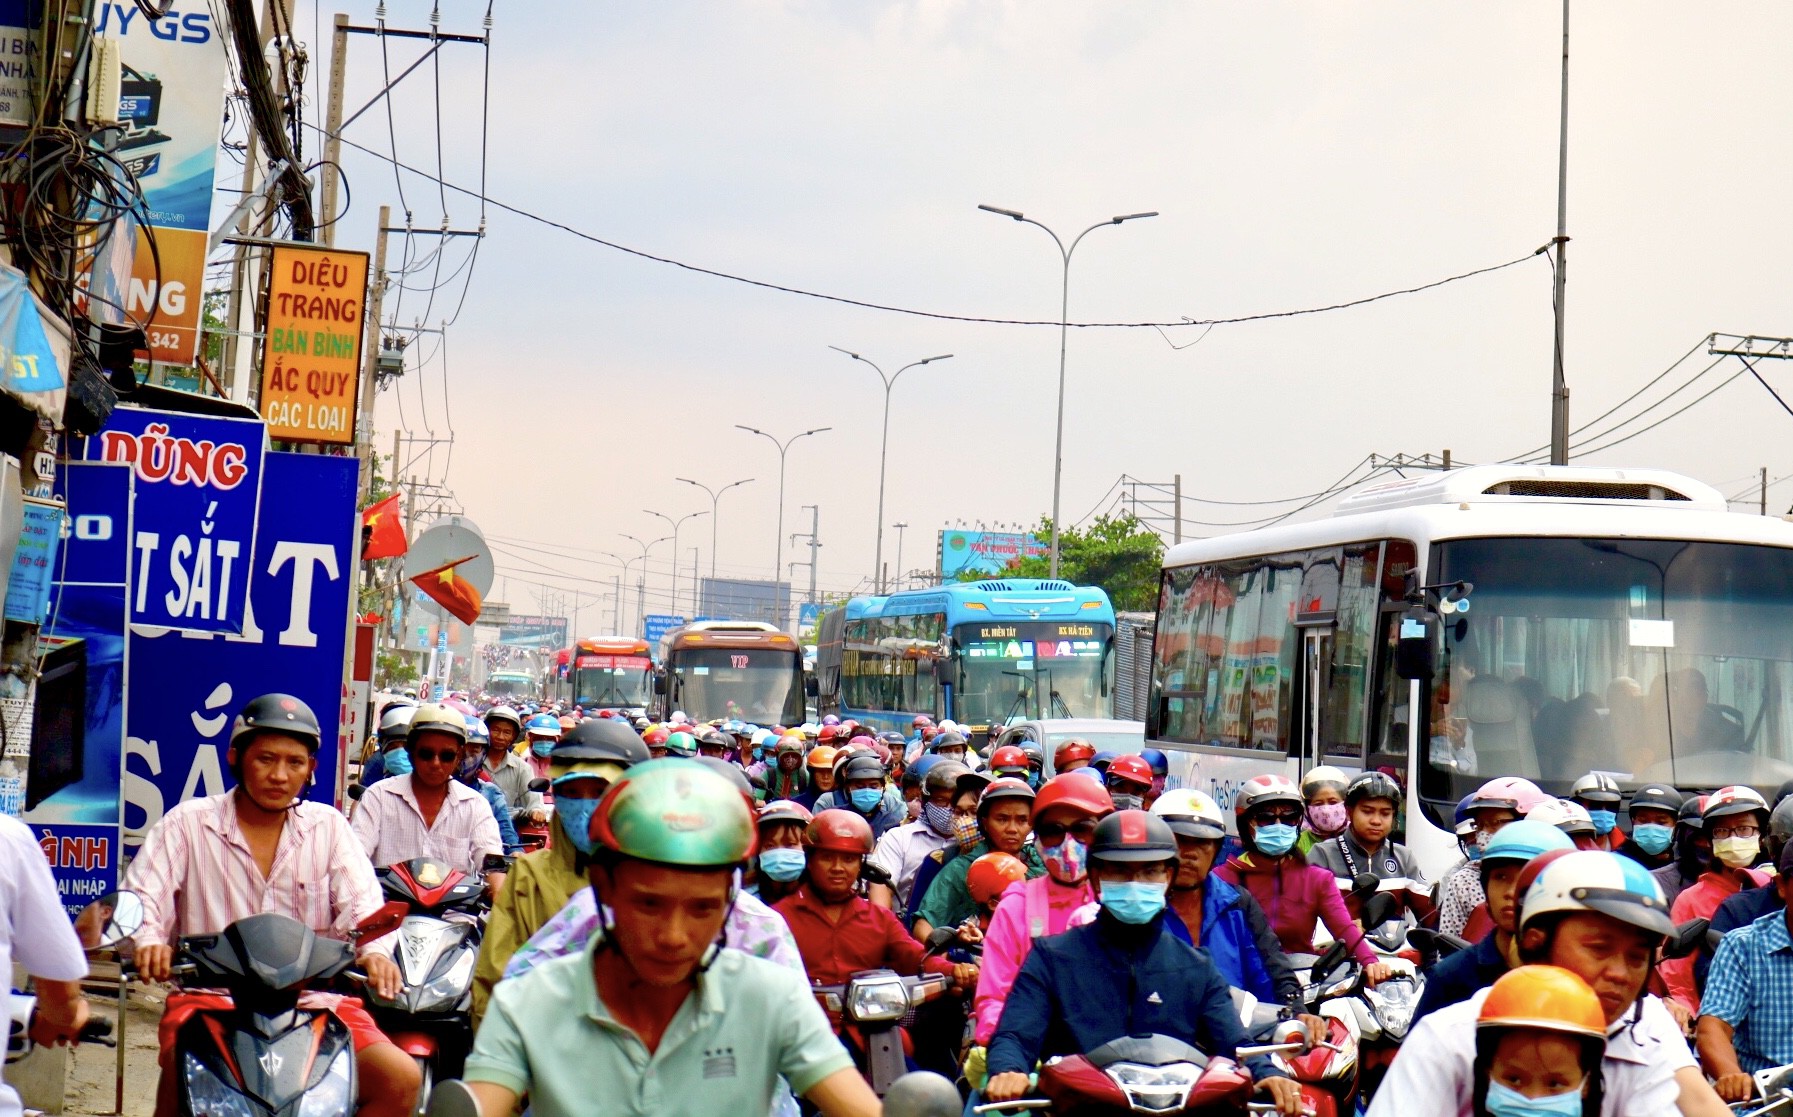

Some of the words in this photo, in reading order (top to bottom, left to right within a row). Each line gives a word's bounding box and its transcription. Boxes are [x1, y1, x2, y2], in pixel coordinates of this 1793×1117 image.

[150, 11, 211, 44] GS
[120, 100, 137, 111] GS
[291, 256, 348, 292] DIỆU
[277, 293, 356, 323] TRANG
[272, 323, 308, 355] BÁN
[313, 326, 355, 360] BÌNH
[269, 356, 299, 392] ẮC
[306, 369, 350, 400] QUY
[267, 395, 302, 428] CÁC
[307, 403, 347, 436] LOẠI
[101, 423, 248, 491] DŨNG
[165, 501, 241, 622] SẮT
[730, 654, 749, 669] VIP
[72, 877, 107, 900] NHẬP
